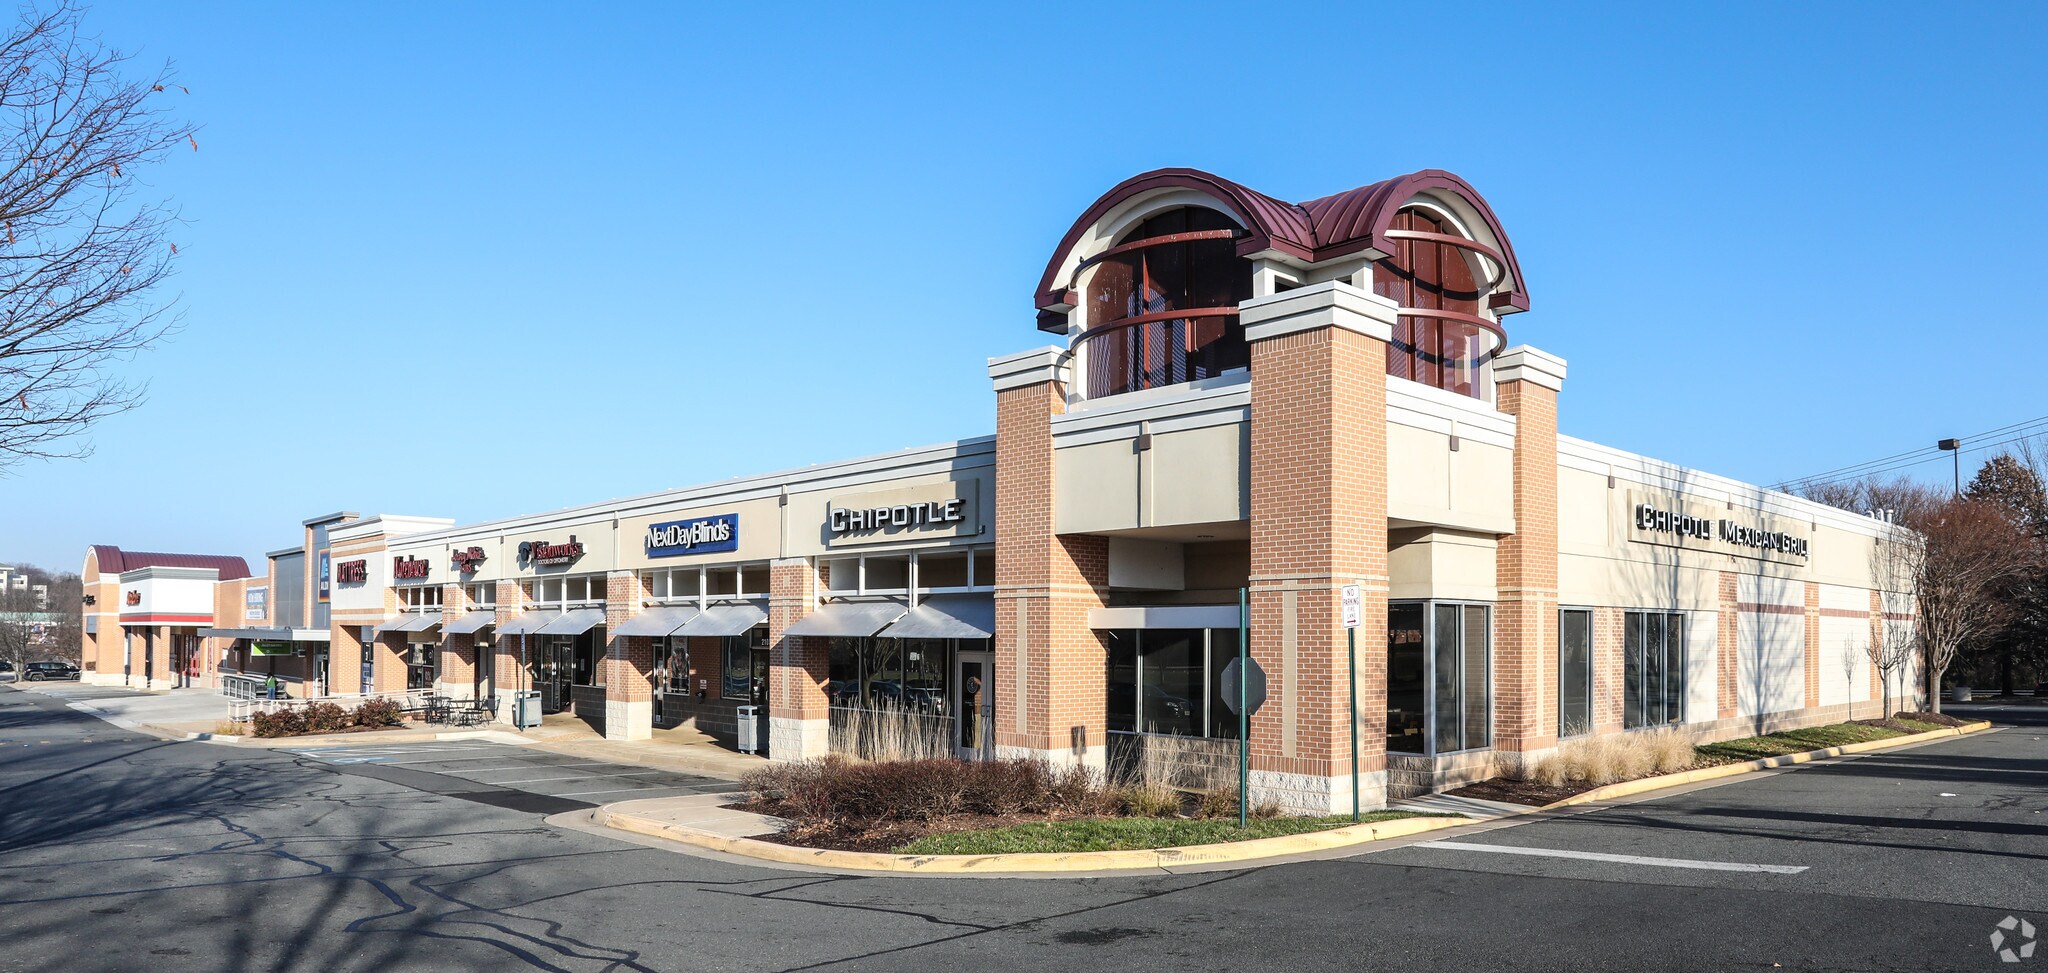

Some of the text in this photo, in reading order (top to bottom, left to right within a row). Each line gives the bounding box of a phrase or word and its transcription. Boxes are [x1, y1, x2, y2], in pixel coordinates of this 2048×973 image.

[831, 499, 960, 532] CHIPOTLE
[1642, 503, 1810, 556] CHIPOTLE MEXICAN GRILL
[1347, 588, 1355, 597] NO
